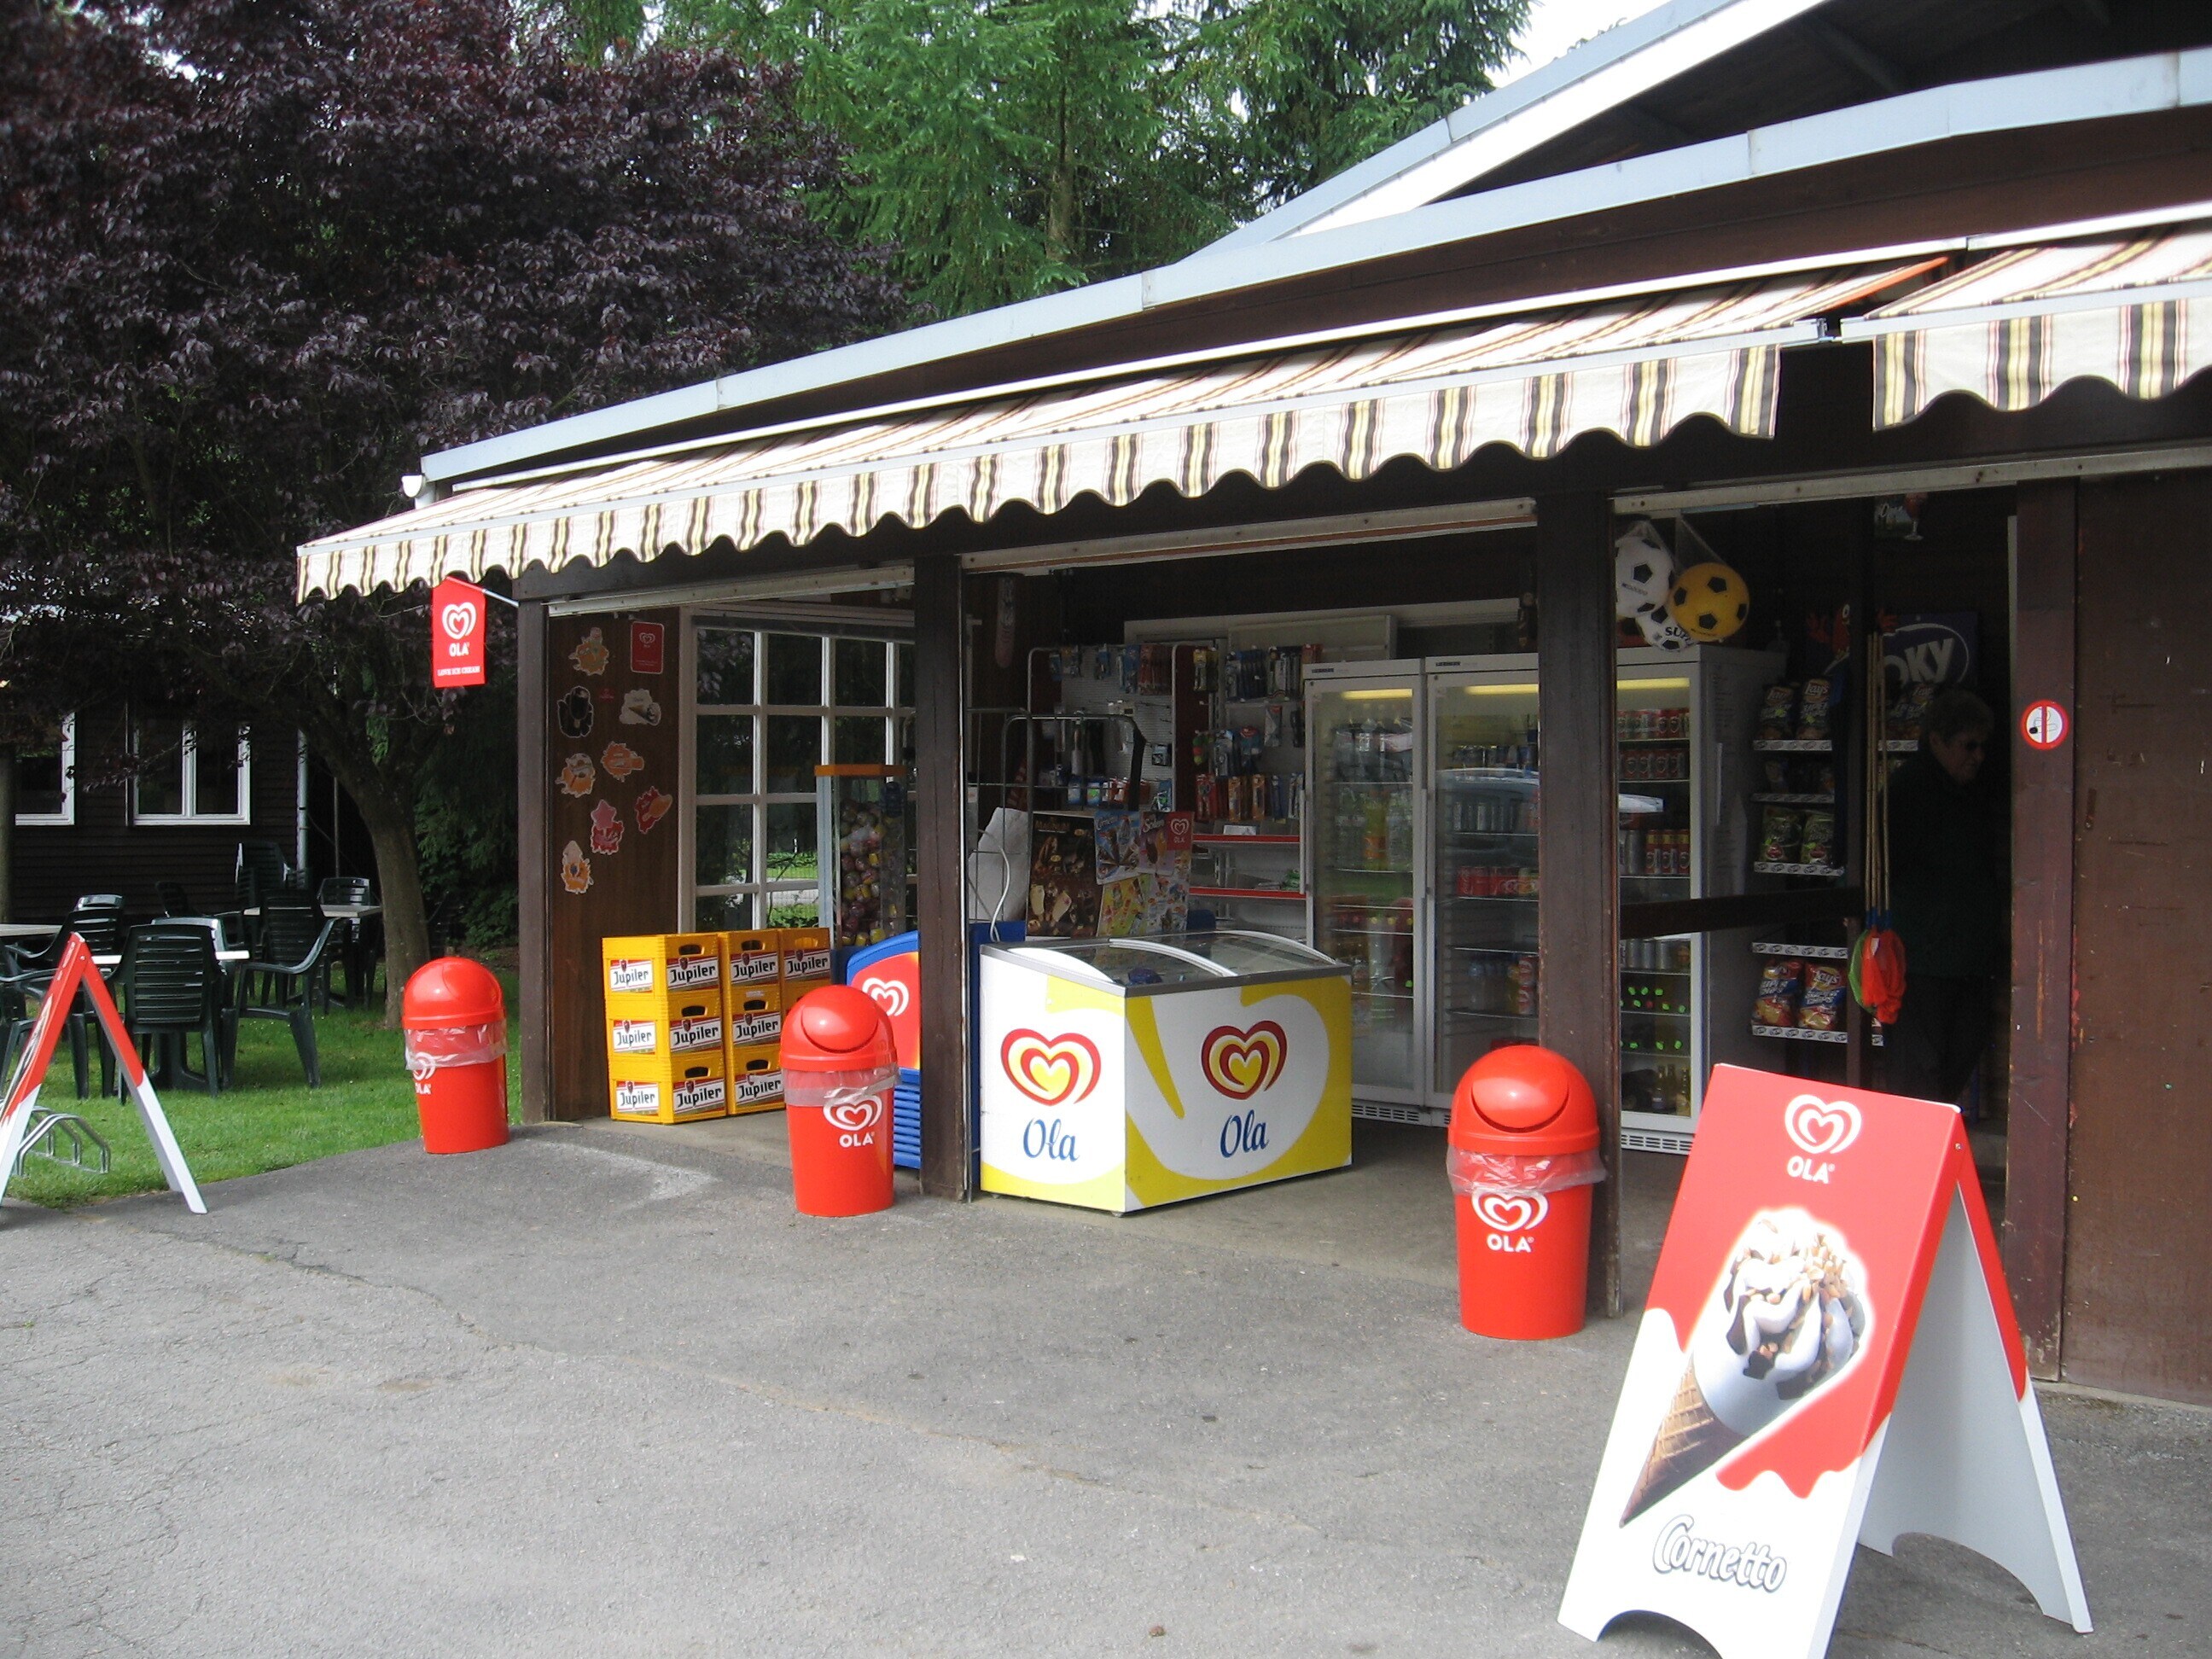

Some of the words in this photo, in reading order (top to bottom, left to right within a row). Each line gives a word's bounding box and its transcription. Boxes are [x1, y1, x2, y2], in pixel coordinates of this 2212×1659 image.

[449, 643, 469, 657] OLA
[670, 964, 716, 983] Jupiler
[733, 960, 776, 980] Jupiler
[787, 956, 829, 975] Jupiler
[613, 969, 649, 984] Jupiler
[616, 1030, 652, 1047] Jupiler
[673, 1026, 719, 1045] Jupiler
[736, 1019, 779, 1039] Jupiler
[620, 1091, 656, 1107] Jupiler
[676, 1086, 722, 1107] Jupiler
[738, 1080, 782, 1100] Jupiler
[839, 1132, 874, 1148] OLA
[1023, 1117, 1080, 1162] Ola
[1220, 1109, 1269, 1158] Ola
[1787, 1155, 1830, 1185] OLA
[1487, 1233, 1532, 1253] OLA
[1653, 1514, 1787, 1594] Cornetto
